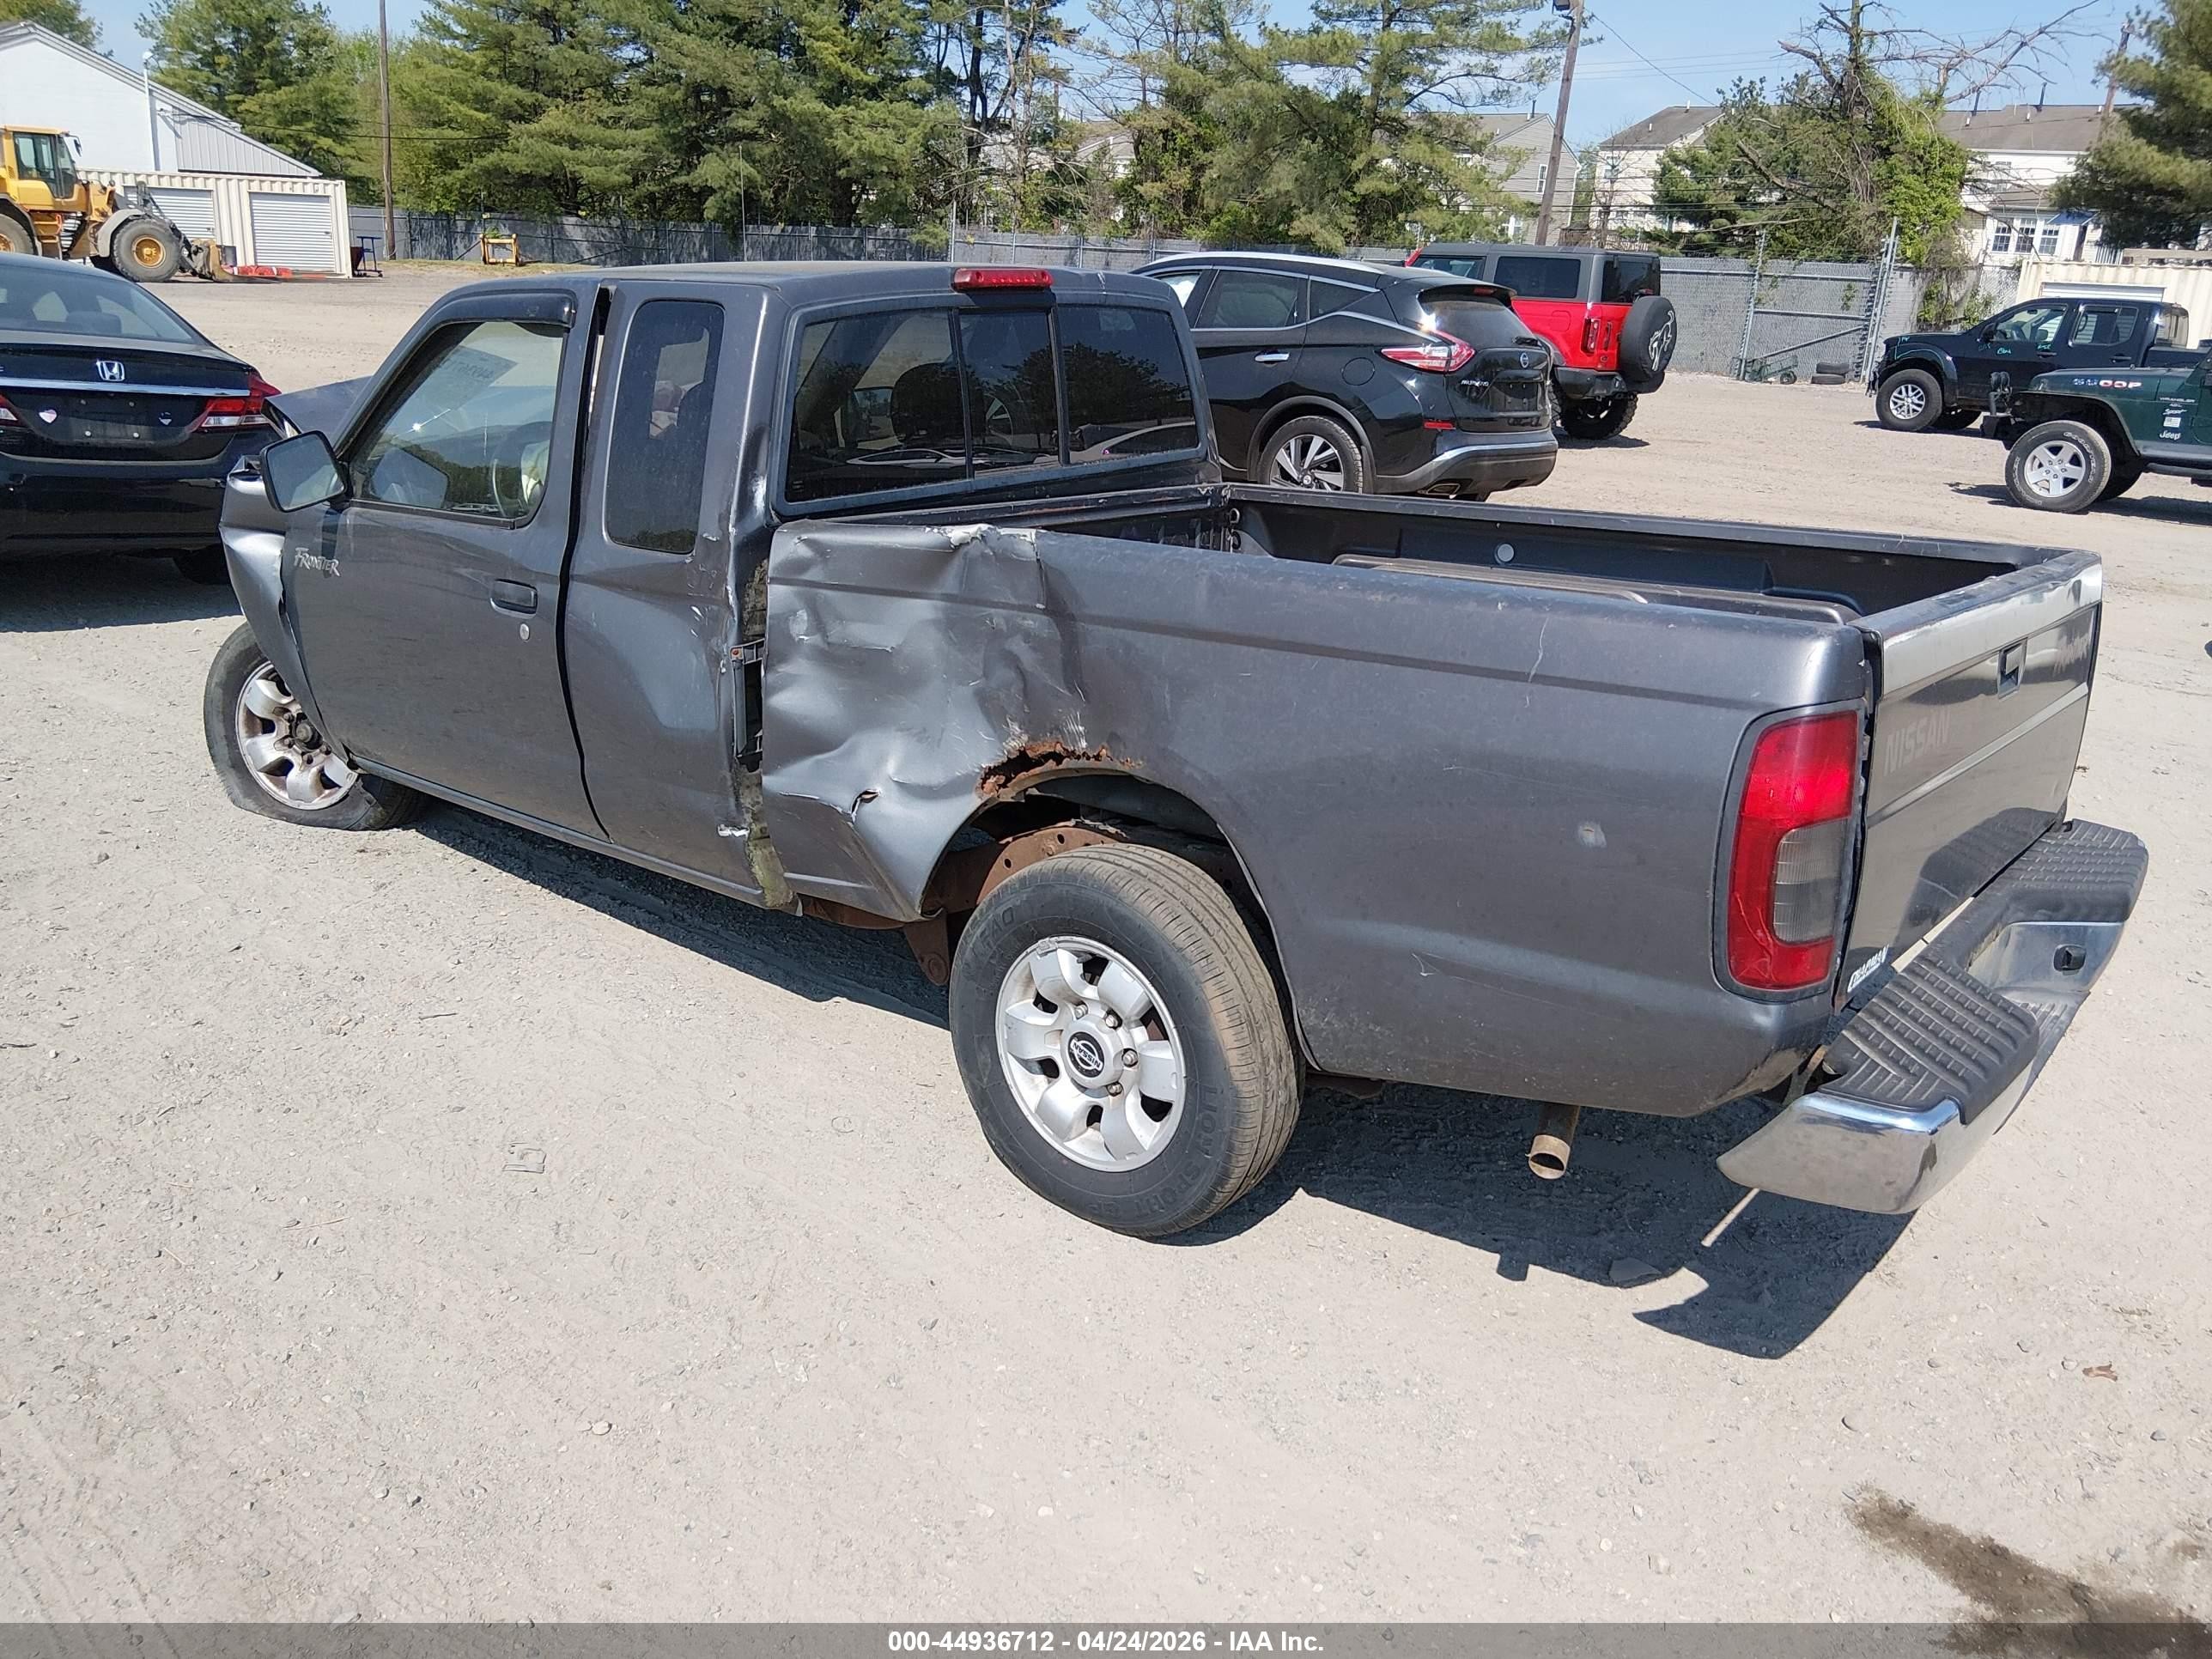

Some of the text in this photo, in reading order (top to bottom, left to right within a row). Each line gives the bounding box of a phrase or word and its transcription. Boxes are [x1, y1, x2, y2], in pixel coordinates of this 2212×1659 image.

[2159, 429, 2181, 441] Jeep
[294, 547, 341, 577] FRONTIER
[1883, 707, 1951, 776] NISSAN
[1072, 1041, 1102, 1069] NISSAN
